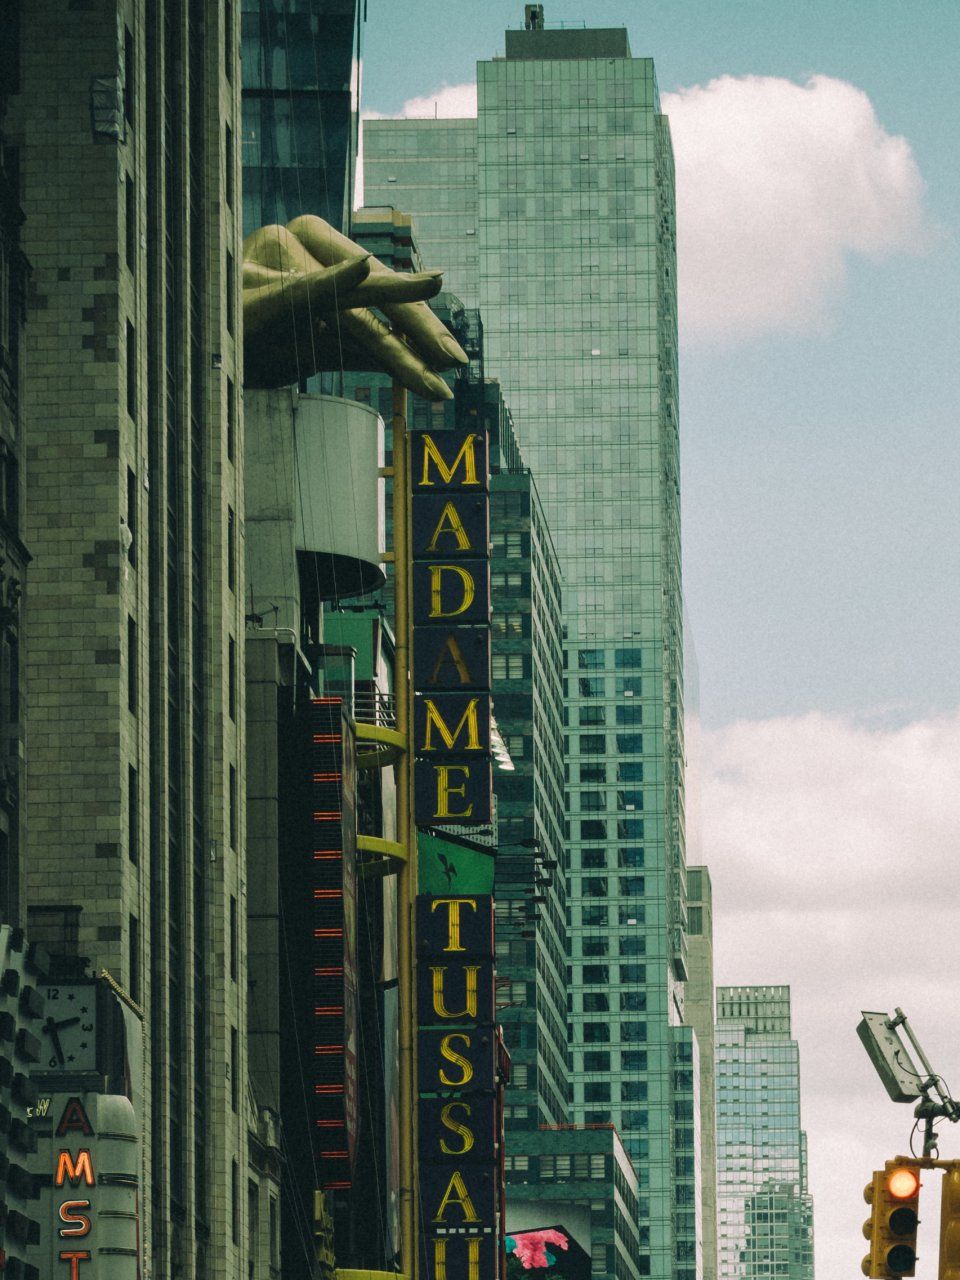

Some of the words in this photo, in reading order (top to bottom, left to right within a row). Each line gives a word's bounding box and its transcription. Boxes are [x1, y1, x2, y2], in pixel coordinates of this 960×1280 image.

[418, 433, 481, 818] MADAME
[46, 988, 60, 1001] 12
[48, 1056, 58, 1068] 6
